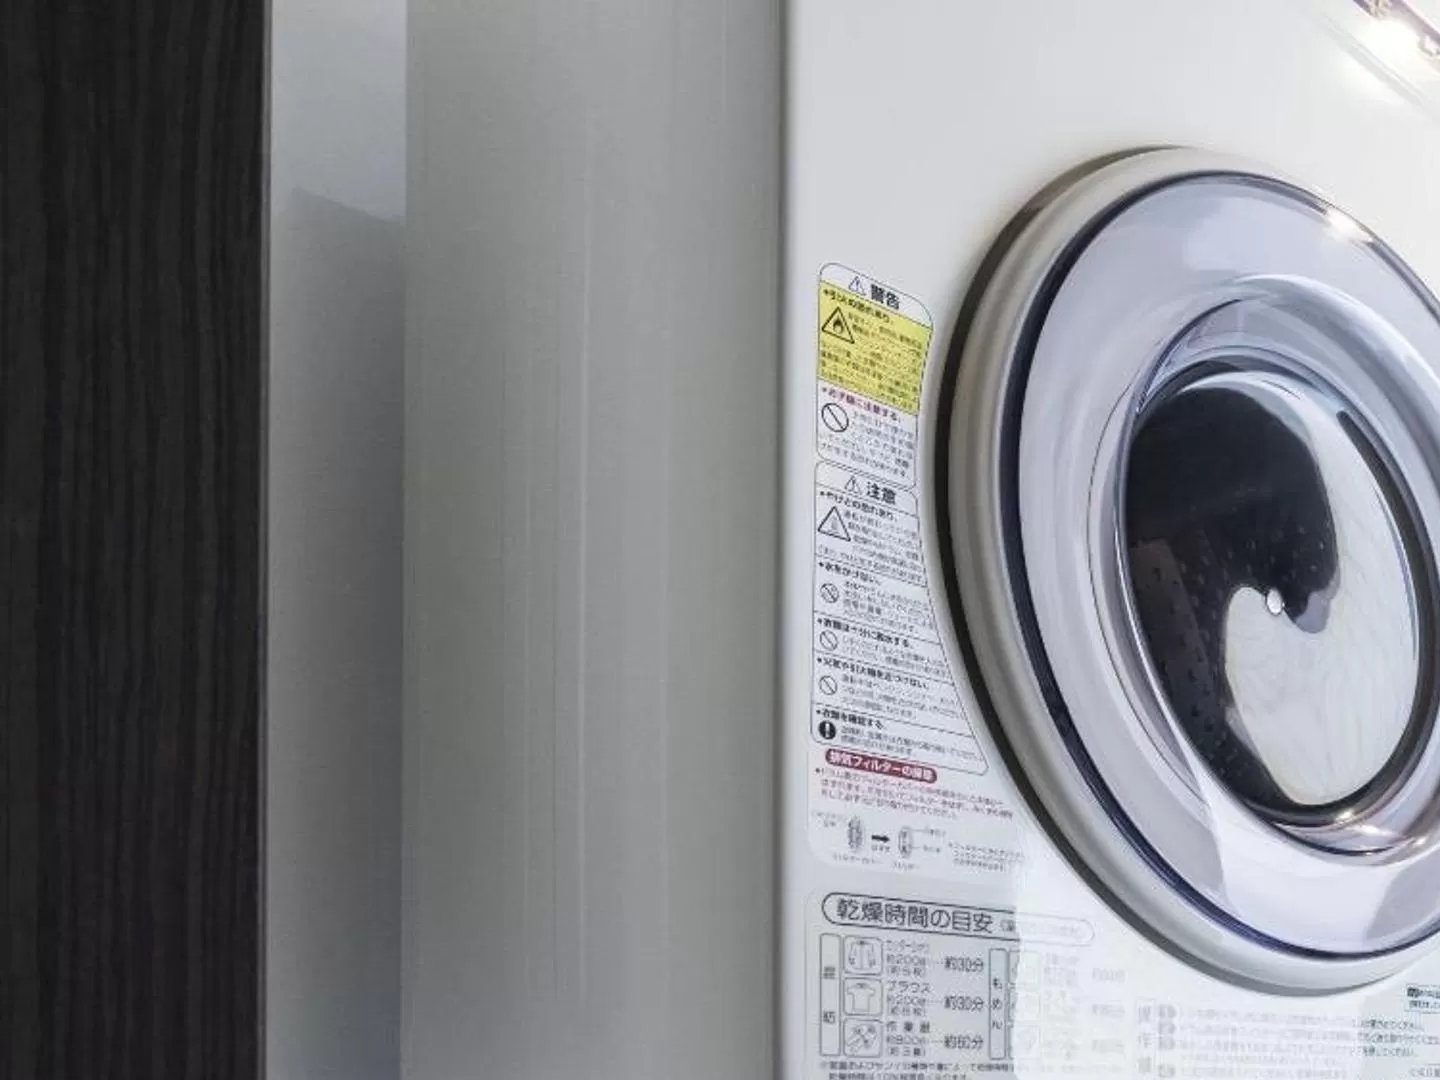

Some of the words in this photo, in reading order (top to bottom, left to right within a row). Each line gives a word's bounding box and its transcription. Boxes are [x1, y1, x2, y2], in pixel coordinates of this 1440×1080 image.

[836, 898, 993, 935] 乾燥時間の目安
